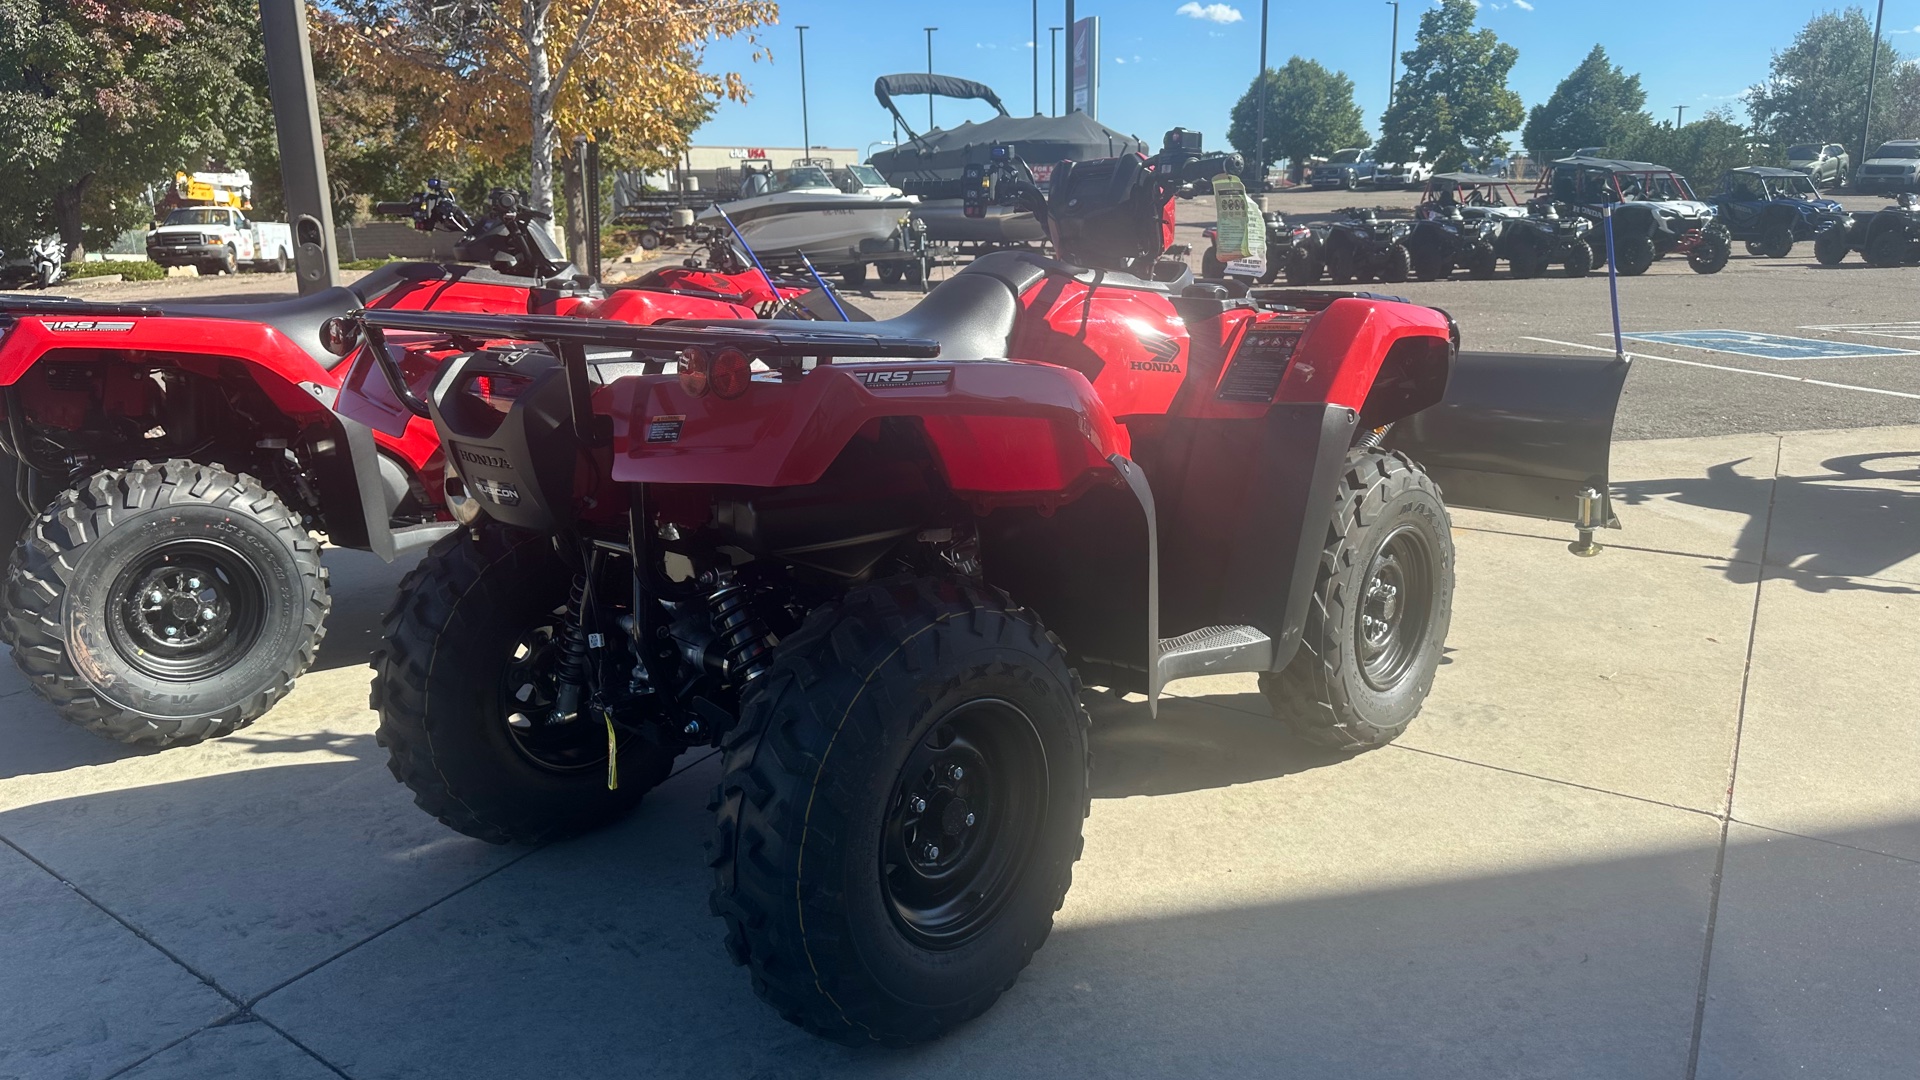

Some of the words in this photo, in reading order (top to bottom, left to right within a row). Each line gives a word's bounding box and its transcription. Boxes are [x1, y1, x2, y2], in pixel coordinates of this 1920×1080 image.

[1572, 205, 1603, 219] HONDA
[53, 321, 95, 329] IRS
[1130, 361, 1181, 373] HONDA
[867, 371, 910, 383] IRS
[459, 450, 514, 470] HONDA
[475, 482, 519, 499] RUBICON
[1399, 501, 1449, 571] MAXXIS
[906, 662, 1050, 736] MAXXIS
